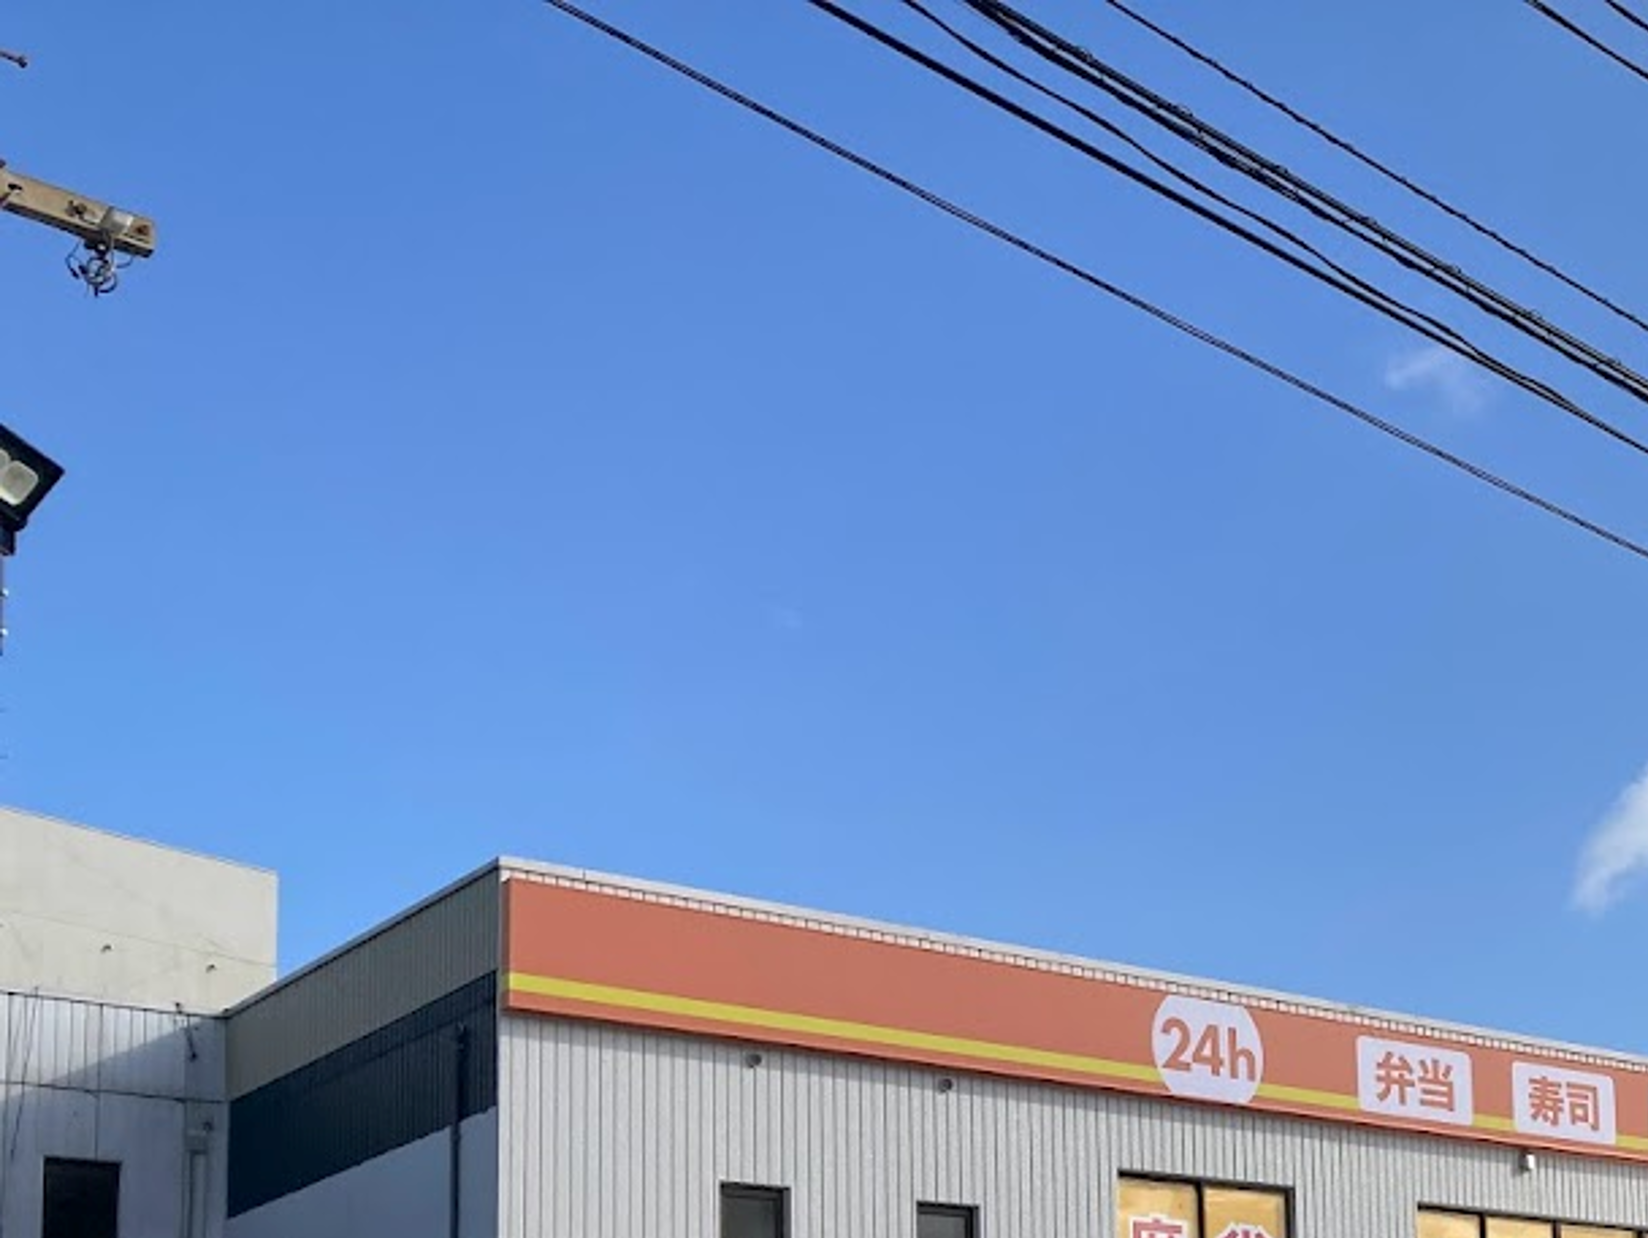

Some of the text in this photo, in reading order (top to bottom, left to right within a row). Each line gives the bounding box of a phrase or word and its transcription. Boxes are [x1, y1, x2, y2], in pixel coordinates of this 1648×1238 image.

[1160, 1015, 1256, 1082] 24h
[1374, 1050, 1455, 1112] 弁当
[1527, 1075, 1600, 1131] 寿司
